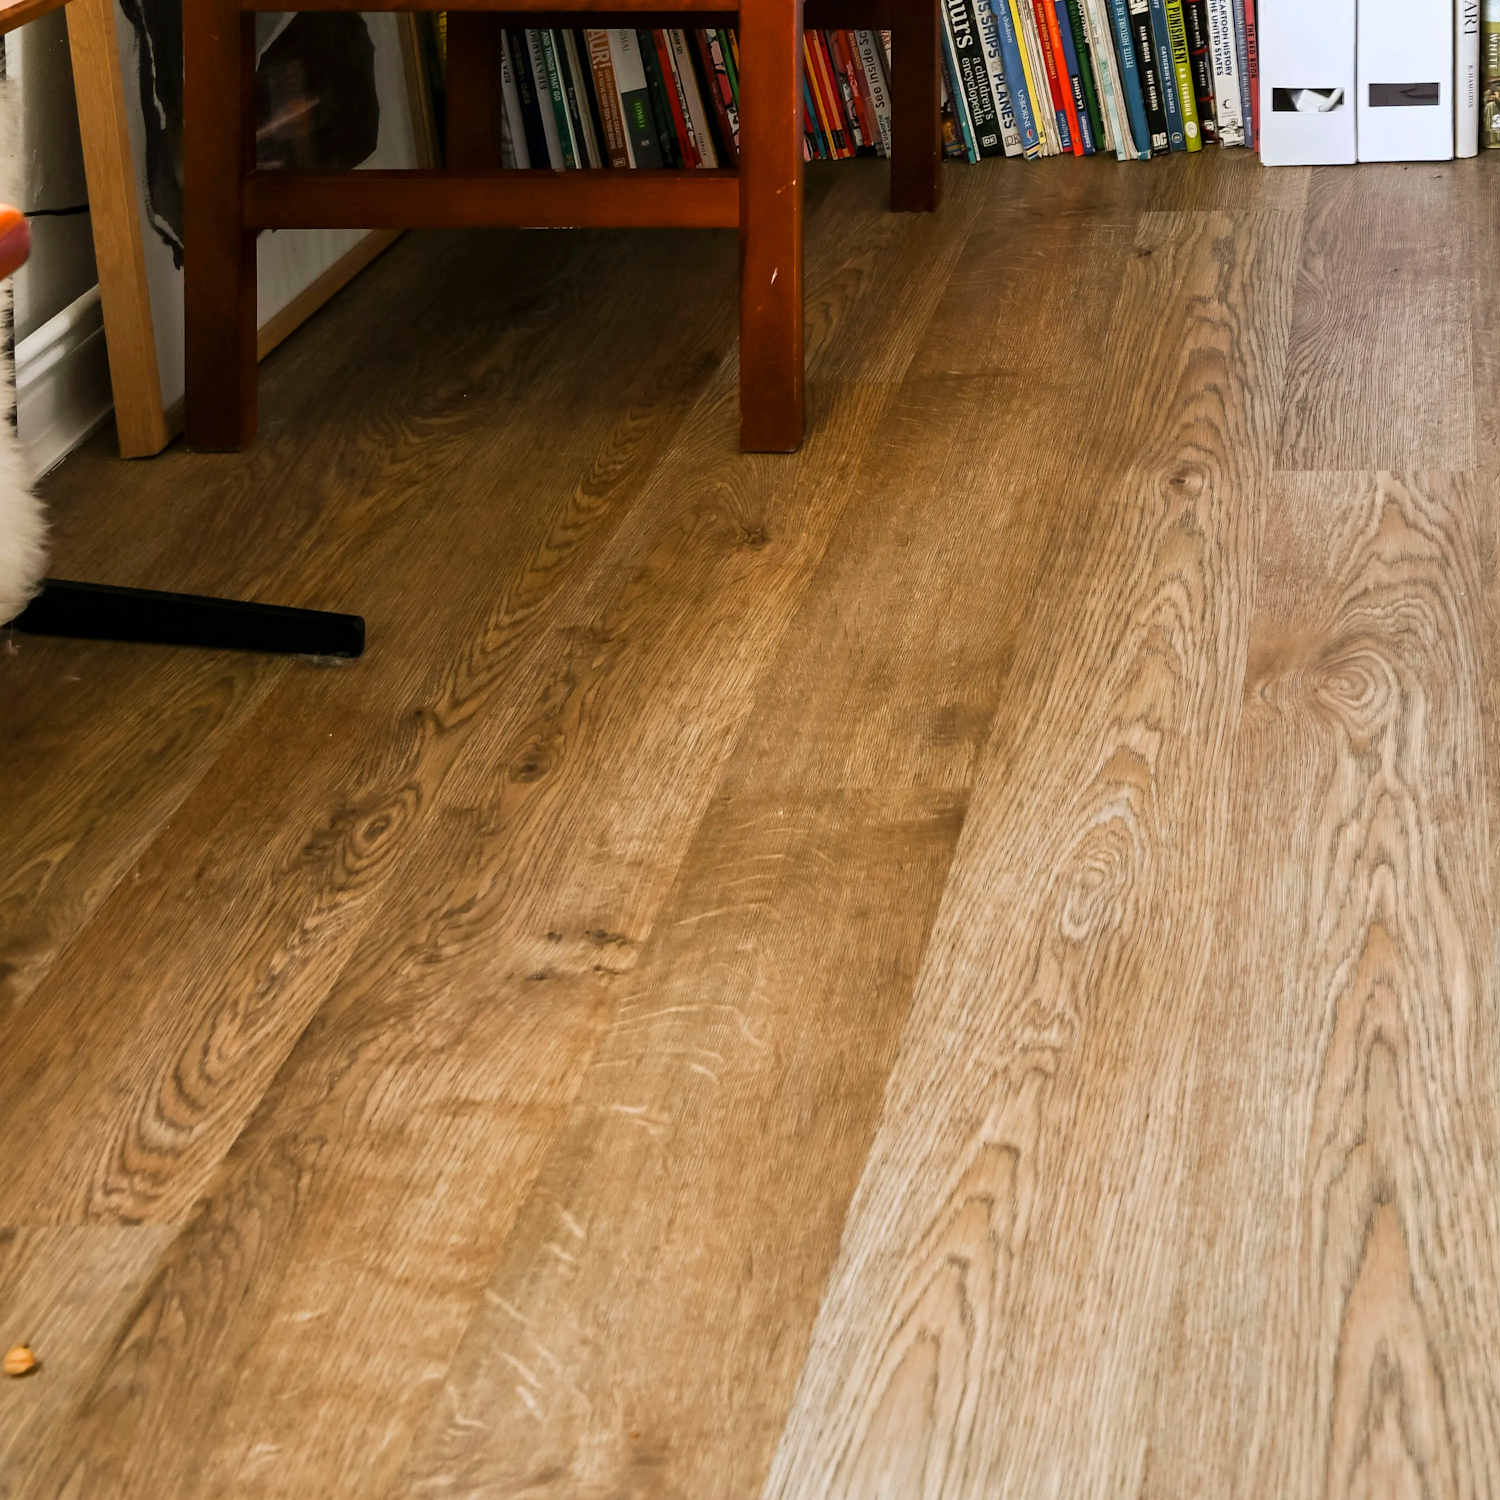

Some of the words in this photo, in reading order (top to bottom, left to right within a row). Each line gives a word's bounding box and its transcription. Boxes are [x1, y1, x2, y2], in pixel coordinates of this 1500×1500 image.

[1166, 6, 1188, 65] PUNISHMENT
[1211, 15, 1221, 46] UNITED
[1123, 48, 1135, 68] PETITE
[1214, 48, 1223, 76] STATES
[1221, 41, 1233, 76] HISTORY
[961, 57, 985, 126] encyclopedia
